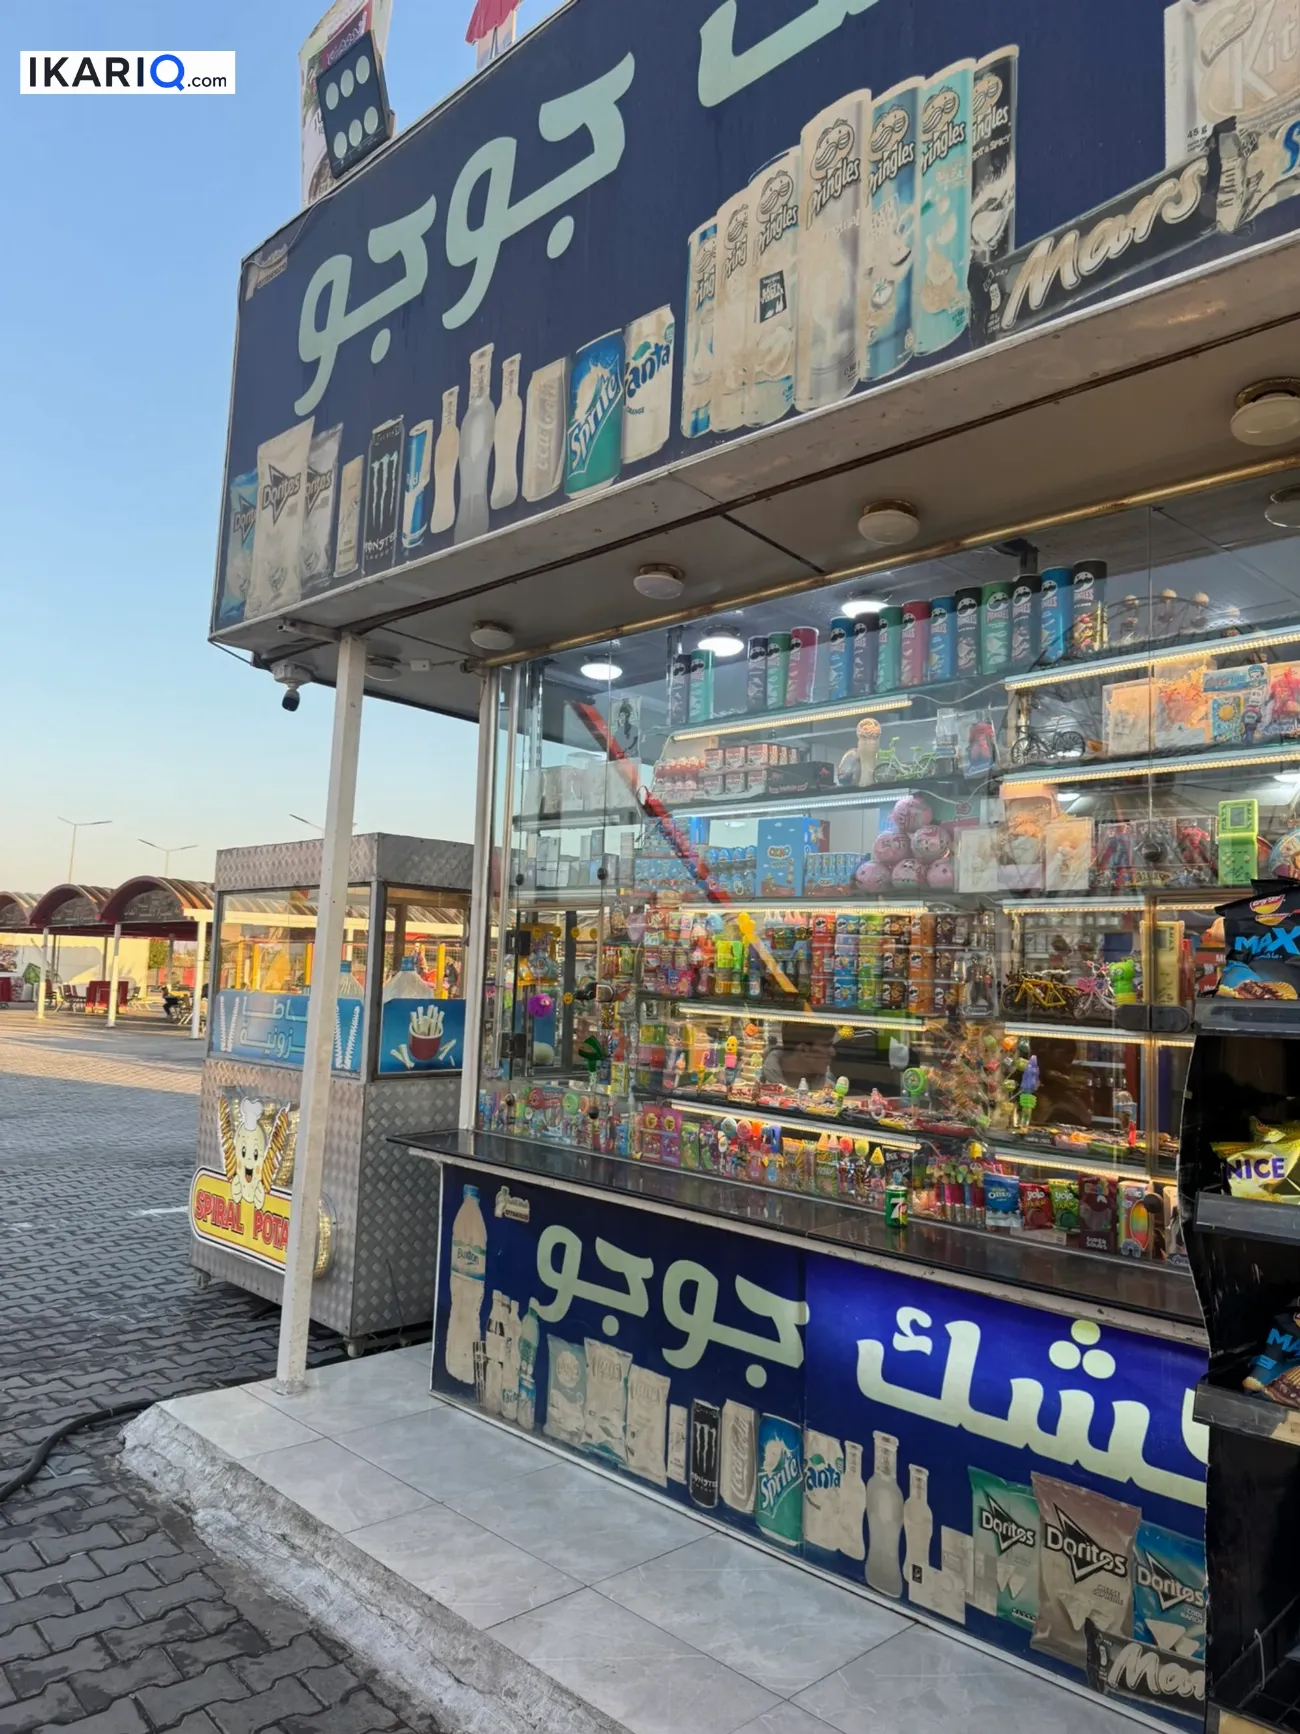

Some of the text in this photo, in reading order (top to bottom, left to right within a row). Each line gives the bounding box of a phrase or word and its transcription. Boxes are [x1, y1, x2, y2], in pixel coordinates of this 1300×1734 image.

[920, 120, 967, 176] ringles
[806, 157, 860, 231] Pringles
[294, 51, 636, 417] جوجو
[752, 204, 799, 269] Pringles
[1001, 156, 1208, 330] Mars
[571, 373, 619, 470] Sprite
[261, 472, 301, 511] Doritos
[1234, 926, 1300, 955] MAX
[1227, 1157, 1286, 1180] NICE
[195, 1189, 244, 1236] SPIRAL
[529, 1225, 811, 1388] جوجو
[760, 1449, 797, 1509] Sprite
[980, 1509, 1036, 1548] Doritos
[1045, 1524, 1129, 1579] Doritos
[1136, 1565, 1206, 1608] Doritos
